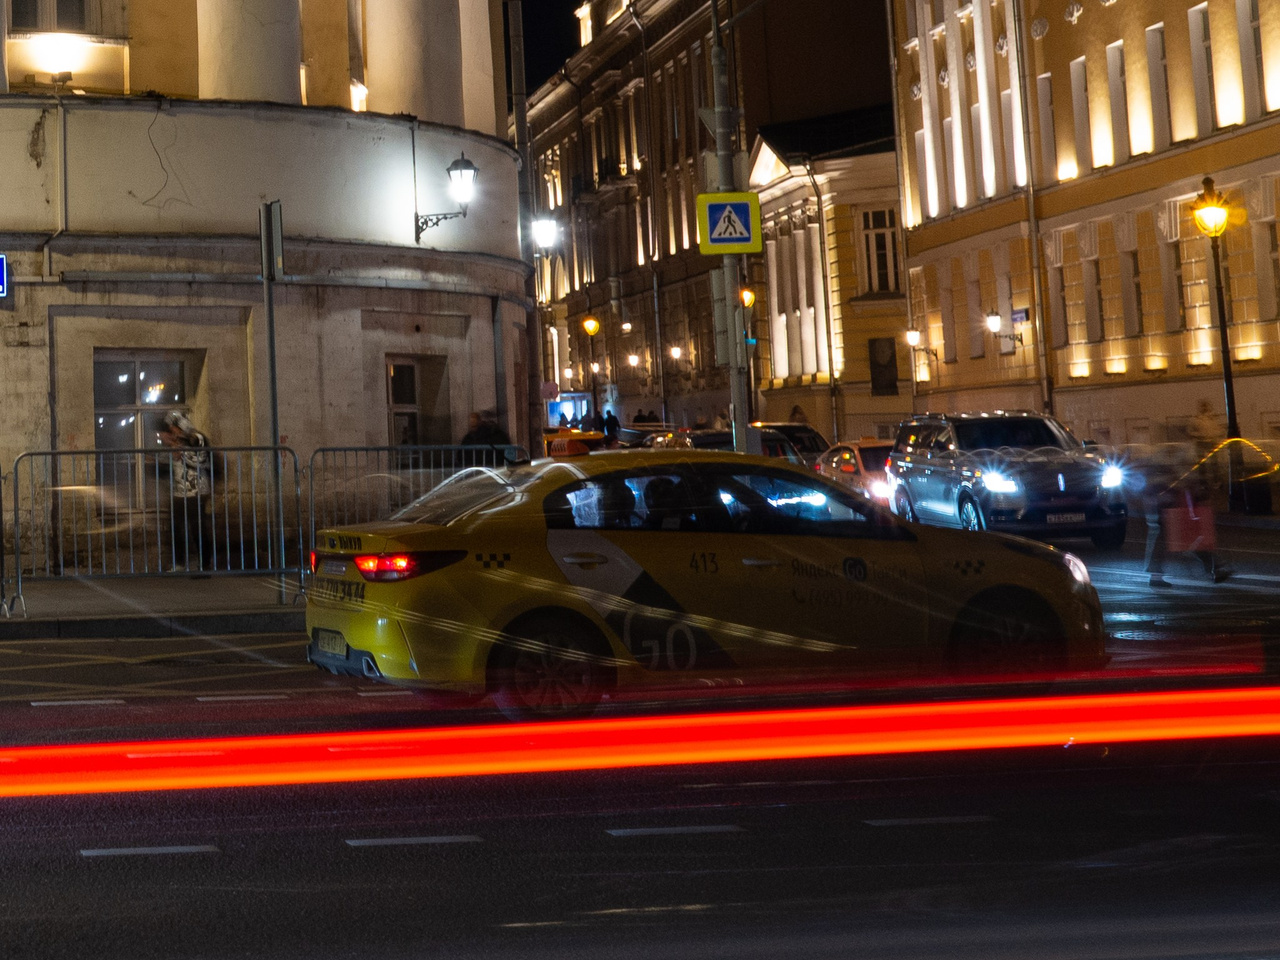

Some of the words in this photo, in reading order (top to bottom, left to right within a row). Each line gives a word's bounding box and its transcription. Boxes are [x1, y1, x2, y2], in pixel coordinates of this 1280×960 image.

[690, 551, 719, 574] 413
[791, 558, 838, 579] Яндекс
[845, 560, 864, 581] Go
